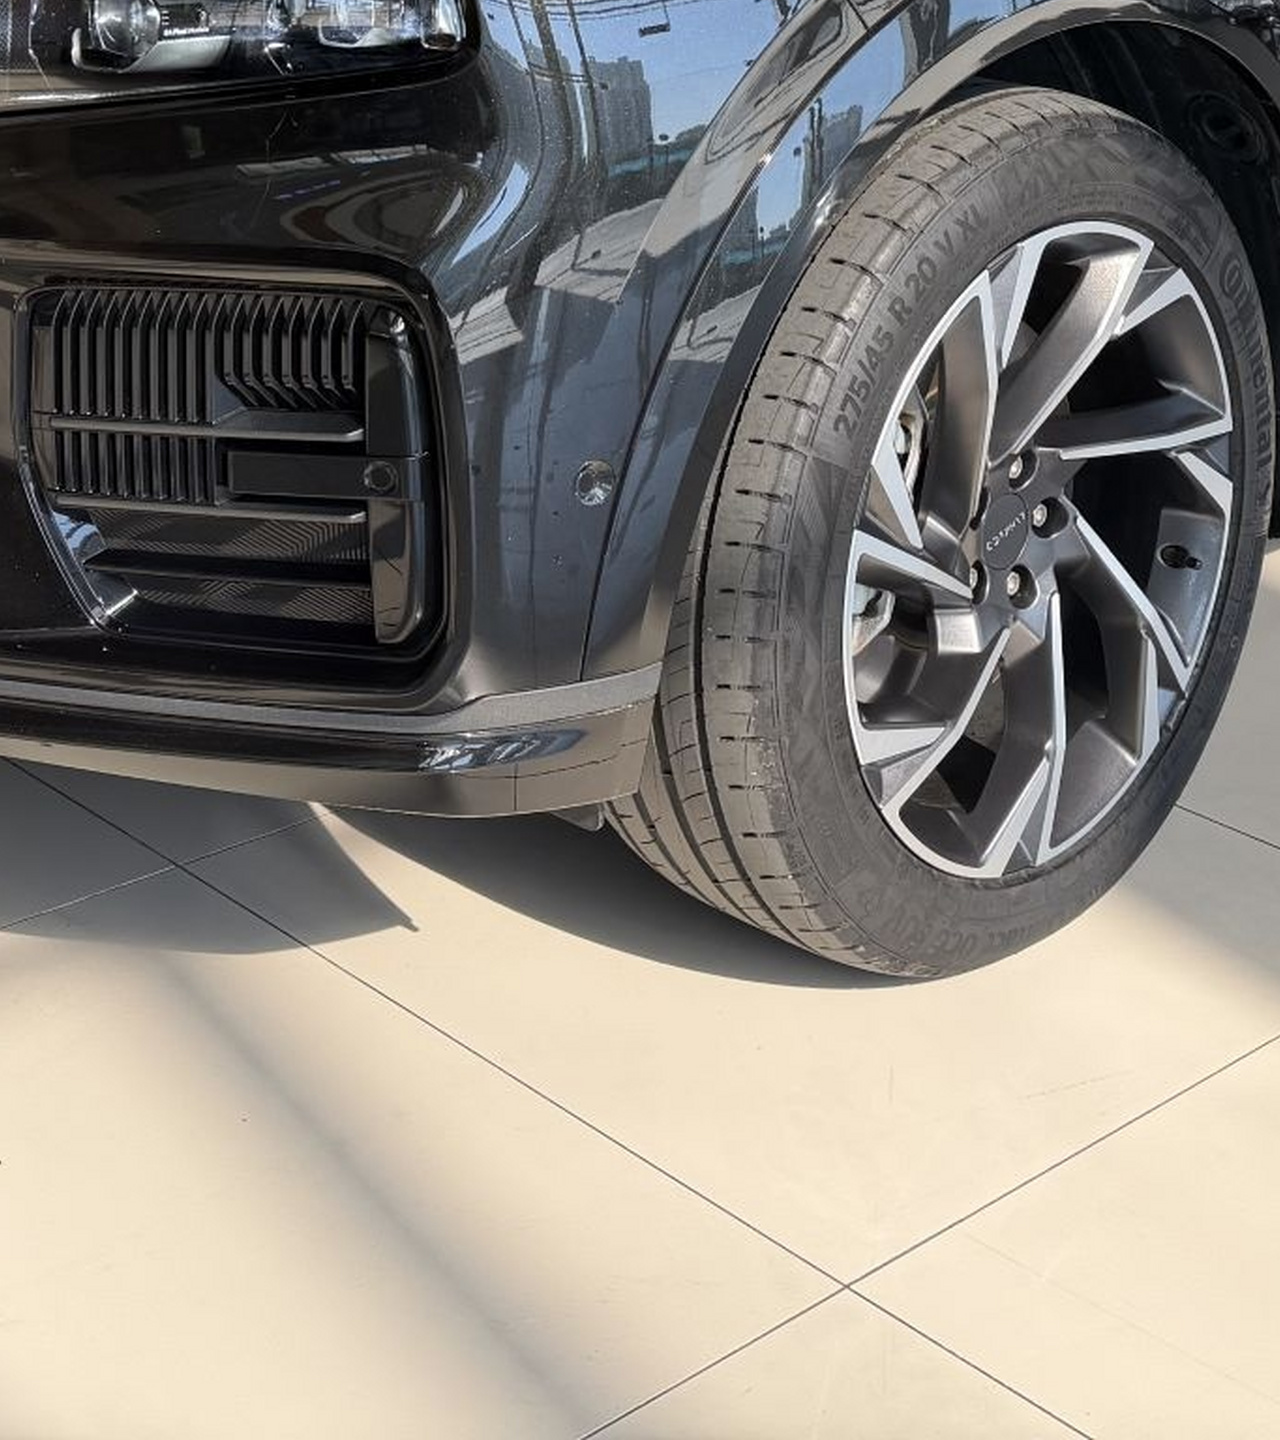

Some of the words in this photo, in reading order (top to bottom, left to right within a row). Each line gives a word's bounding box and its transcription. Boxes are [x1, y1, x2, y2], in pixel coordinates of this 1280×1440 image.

[833, 324, 895, 438] 275/45
[887, 295, 913, 326] R
[904, 262, 938, 308] 20
